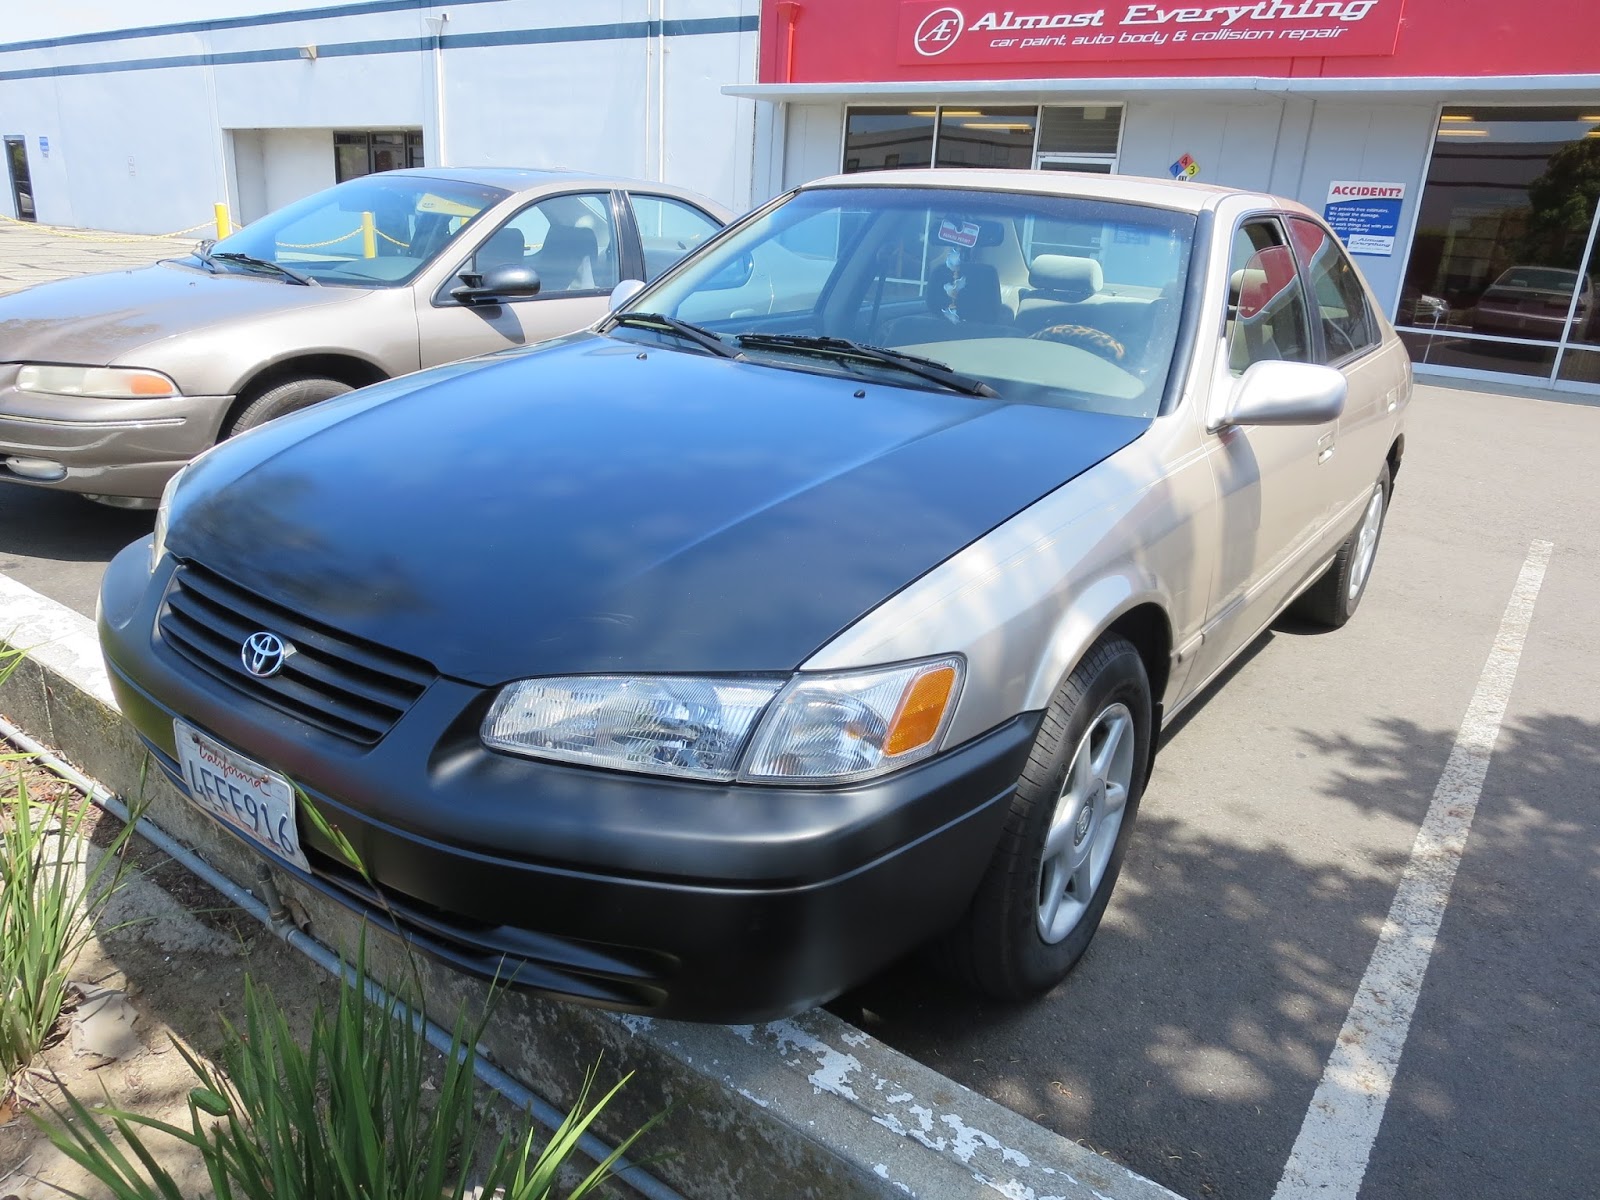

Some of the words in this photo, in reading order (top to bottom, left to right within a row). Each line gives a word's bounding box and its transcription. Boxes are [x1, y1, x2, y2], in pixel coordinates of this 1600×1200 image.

[968, 10, 1105, 31] Almost
[1118, 0, 1379, 26] Everything
[989, 37, 1019, 48] car
[1071, 33, 1114, 45] auto
[1118, 31, 1168, 45] body
[1172, 30, 1188, 42] &
[1191, 28, 1274, 41] collision
[1279, 26, 1349, 42] repair
[1181, 156, 1188, 166] 4
[1174, 164, 1179, 174] 1
[1189, 165, 1196, 175] 3
[1331, 186, 1402, 197] ACCIDENT?
[198, 740, 271, 797] California
